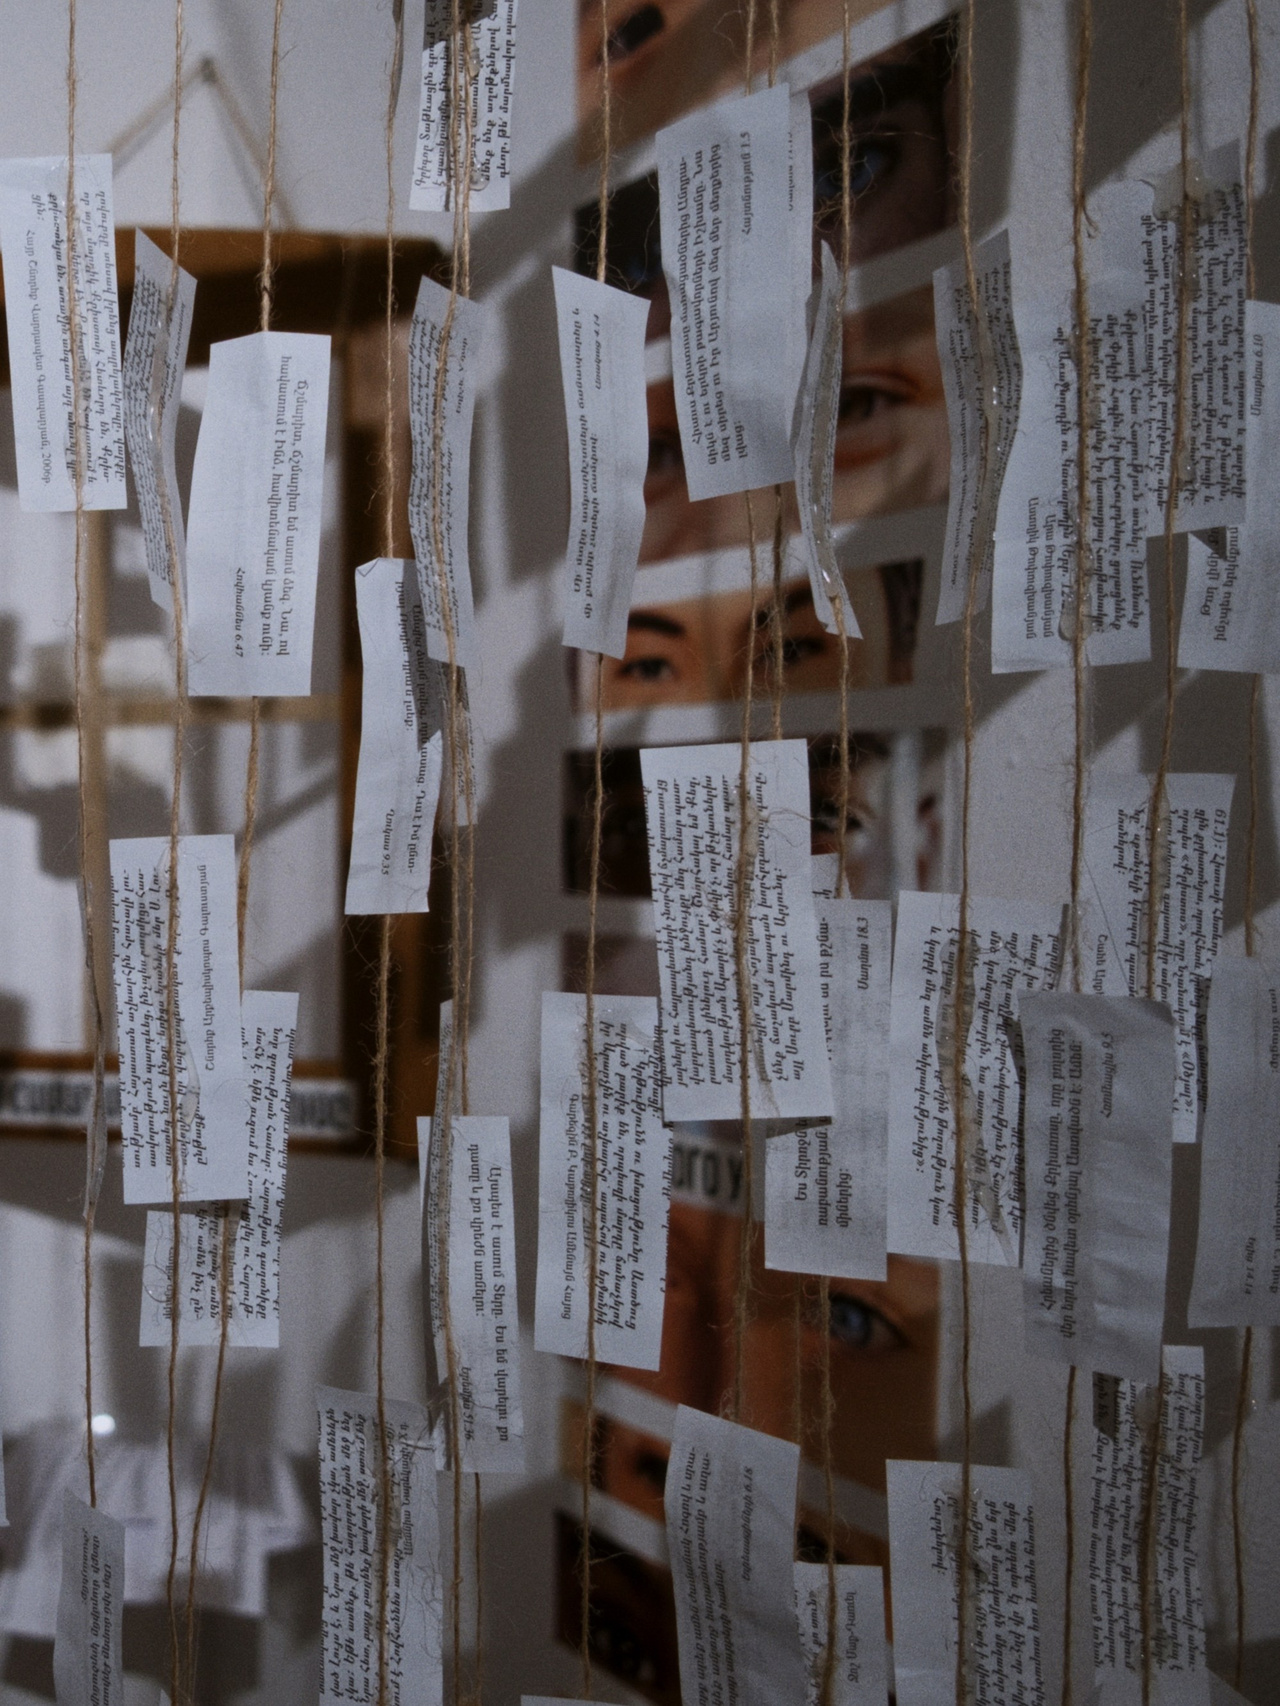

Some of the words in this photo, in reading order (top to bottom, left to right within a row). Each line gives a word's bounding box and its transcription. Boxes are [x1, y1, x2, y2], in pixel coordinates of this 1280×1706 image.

[708, 143, 722, 212] մեղքերից
[708, 216, 722, 243] մեր
[707, 245, 722, 273] մեզ
[706, 276, 721, 343] Արյունով
[709, 346, 722, 368] Իր
[275, 355, 292, 425] հավատում
[712, 371, 721, 386] ու
[714, 390, 728, 432] սիրեց
[271, 438, 286, 470] Ինձ,
[720, 435, 731, 462] մեզ
[285, 449, 303, 512] ճշմարիտ
[263, 472, 283, 575] հավիտենական
[285, 515, 299, 532] եմ
[283, 534, 295, 574] ասում
[259, 578, 276, 620] կյանք
[278, 577, 294, 604] ձեզ.
[277, 607, 293, 637] Նա,
[258, 622, 273, 655] ունի։
[275, 639, 290, 656] ով
